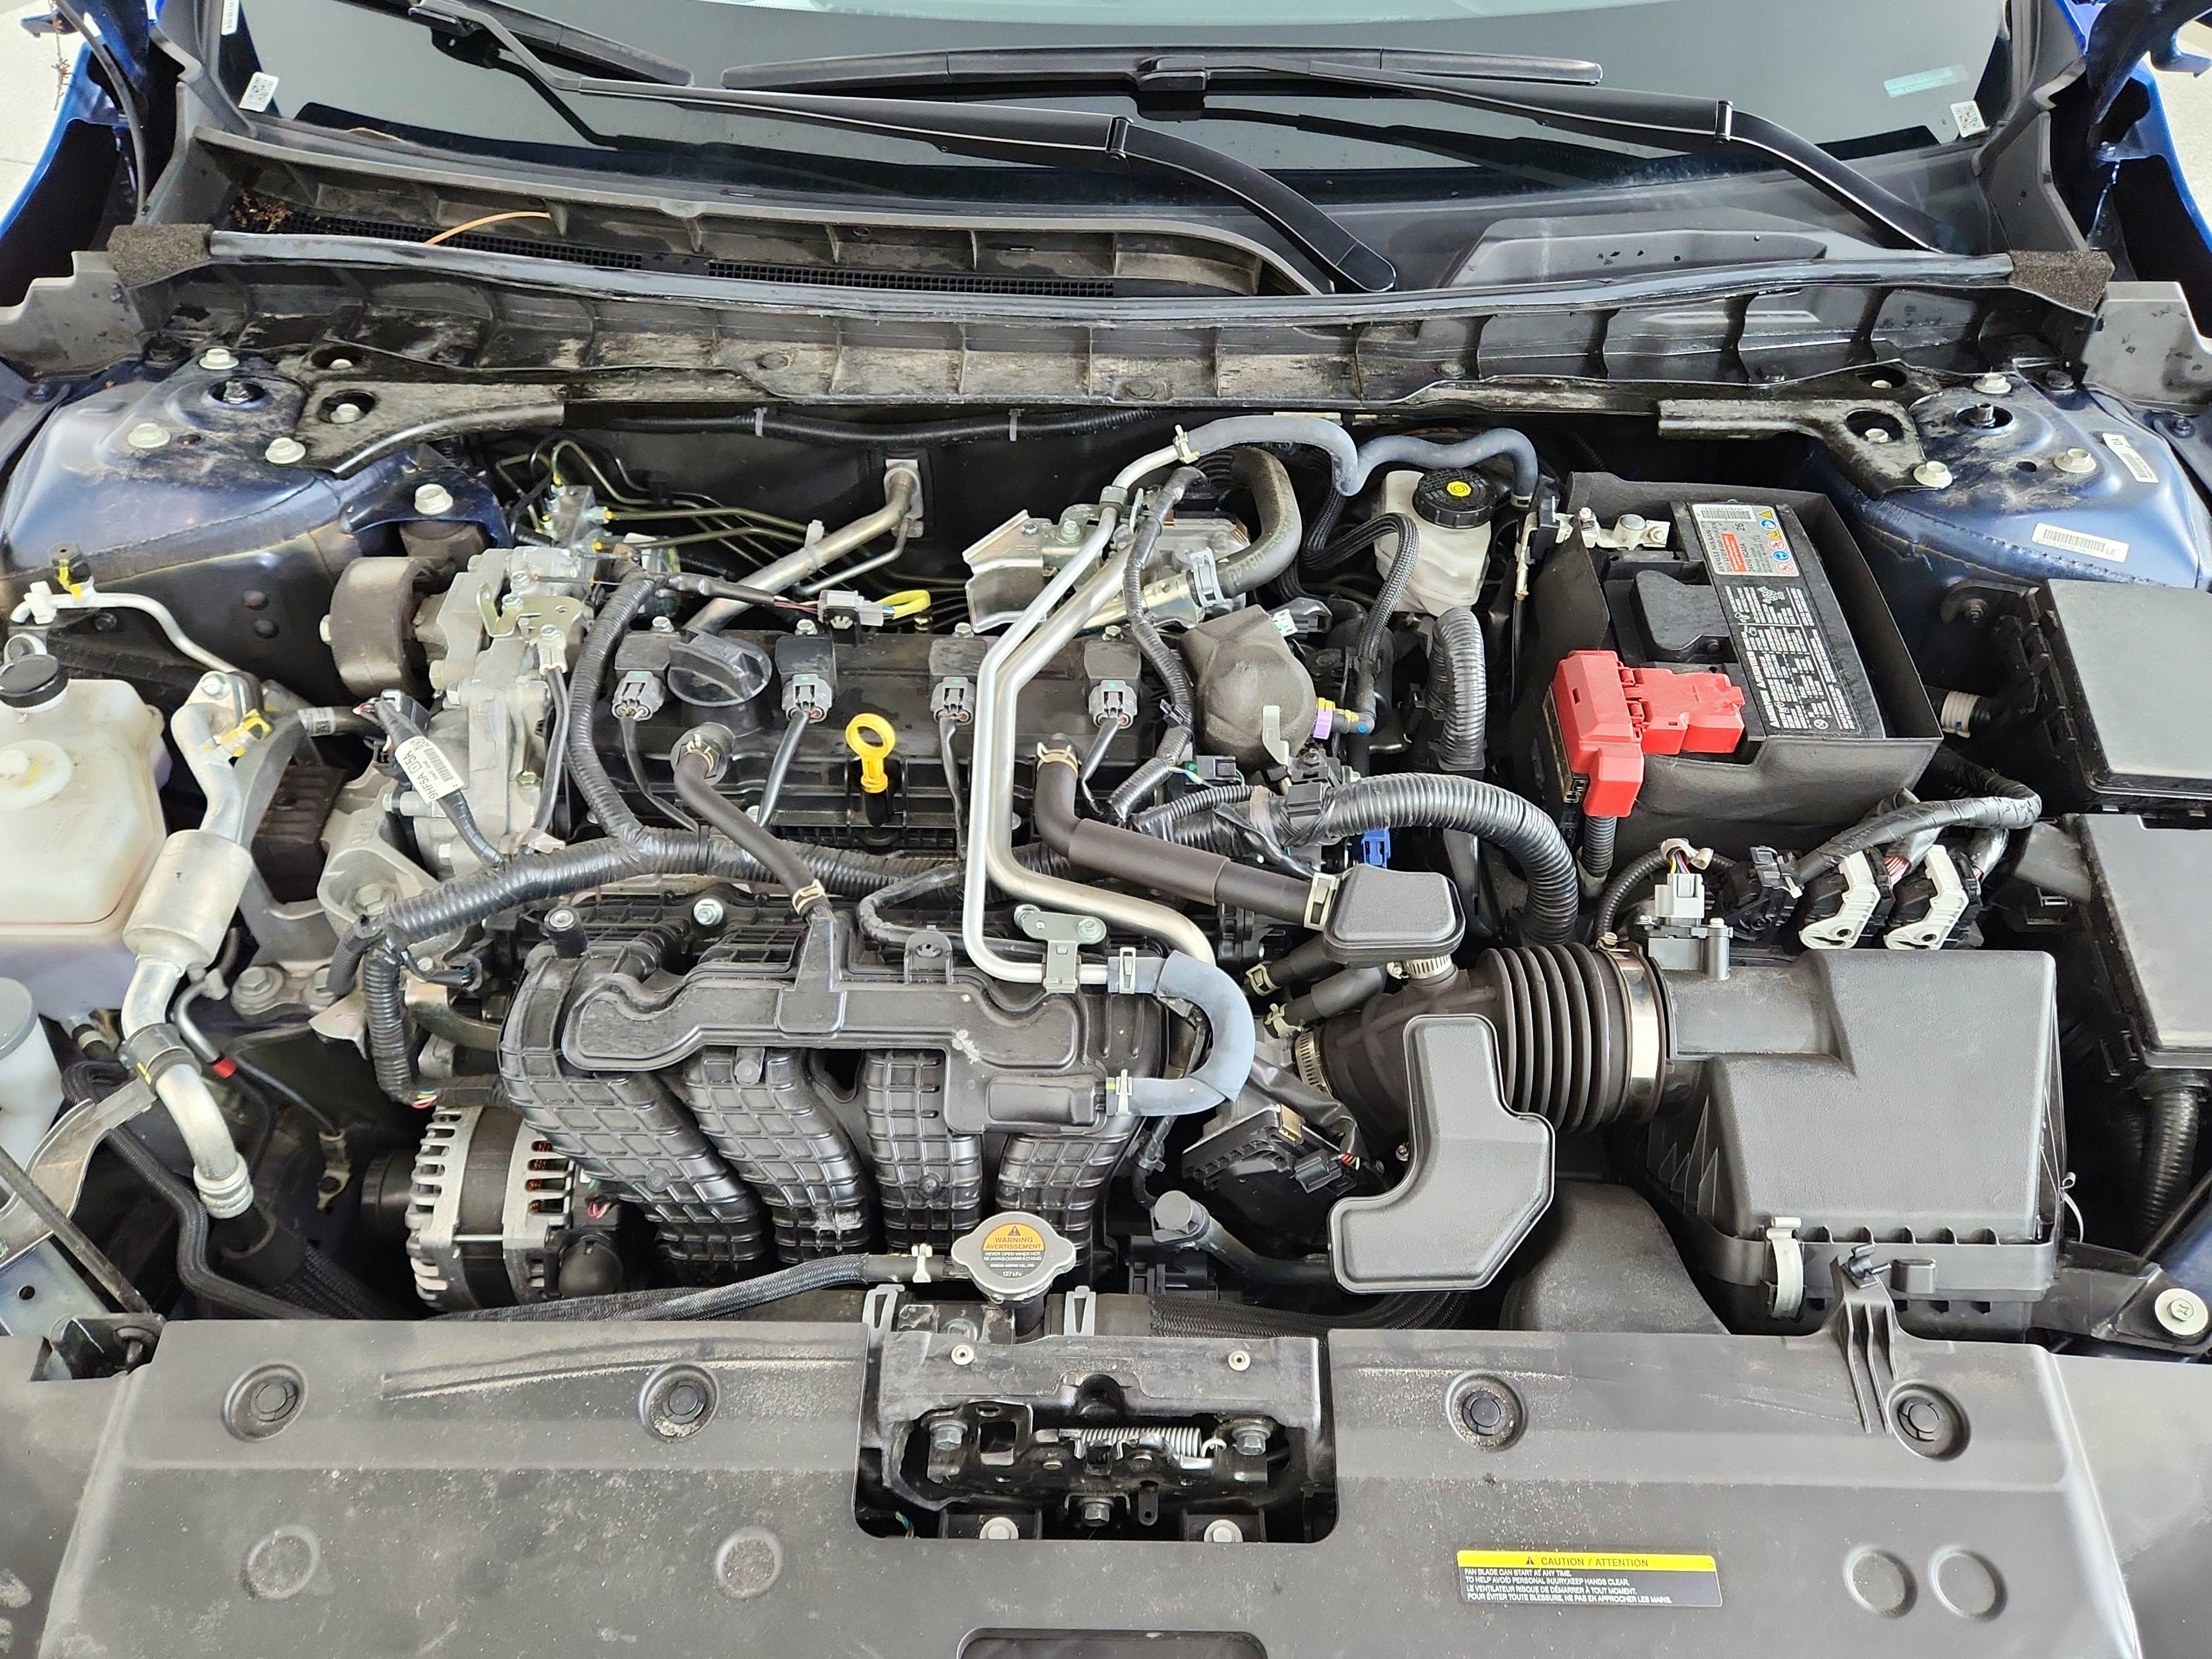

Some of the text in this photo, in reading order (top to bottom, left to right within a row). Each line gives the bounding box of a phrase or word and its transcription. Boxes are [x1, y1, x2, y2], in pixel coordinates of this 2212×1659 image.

[1735, 523, 1745, 531] 26
[1705, 529, 1717, 550] NISSAN
[1713, 551, 1725, 572] RENAULT
[403, 749, 416, 766] 5A
[417, 772, 439, 799] 9HF5A
[1541, 1557, 1584, 1565] CAUTION
[1596, 1559, 1648, 1567] ATTENTION
[1487, 1592, 1507, 1600] ÉVITER
[1516, 1585, 1539, 1594] RISQUE
[1550, 1585, 1584, 1594] DÉMARRER
[1585, 1585, 1590, 1594] À
